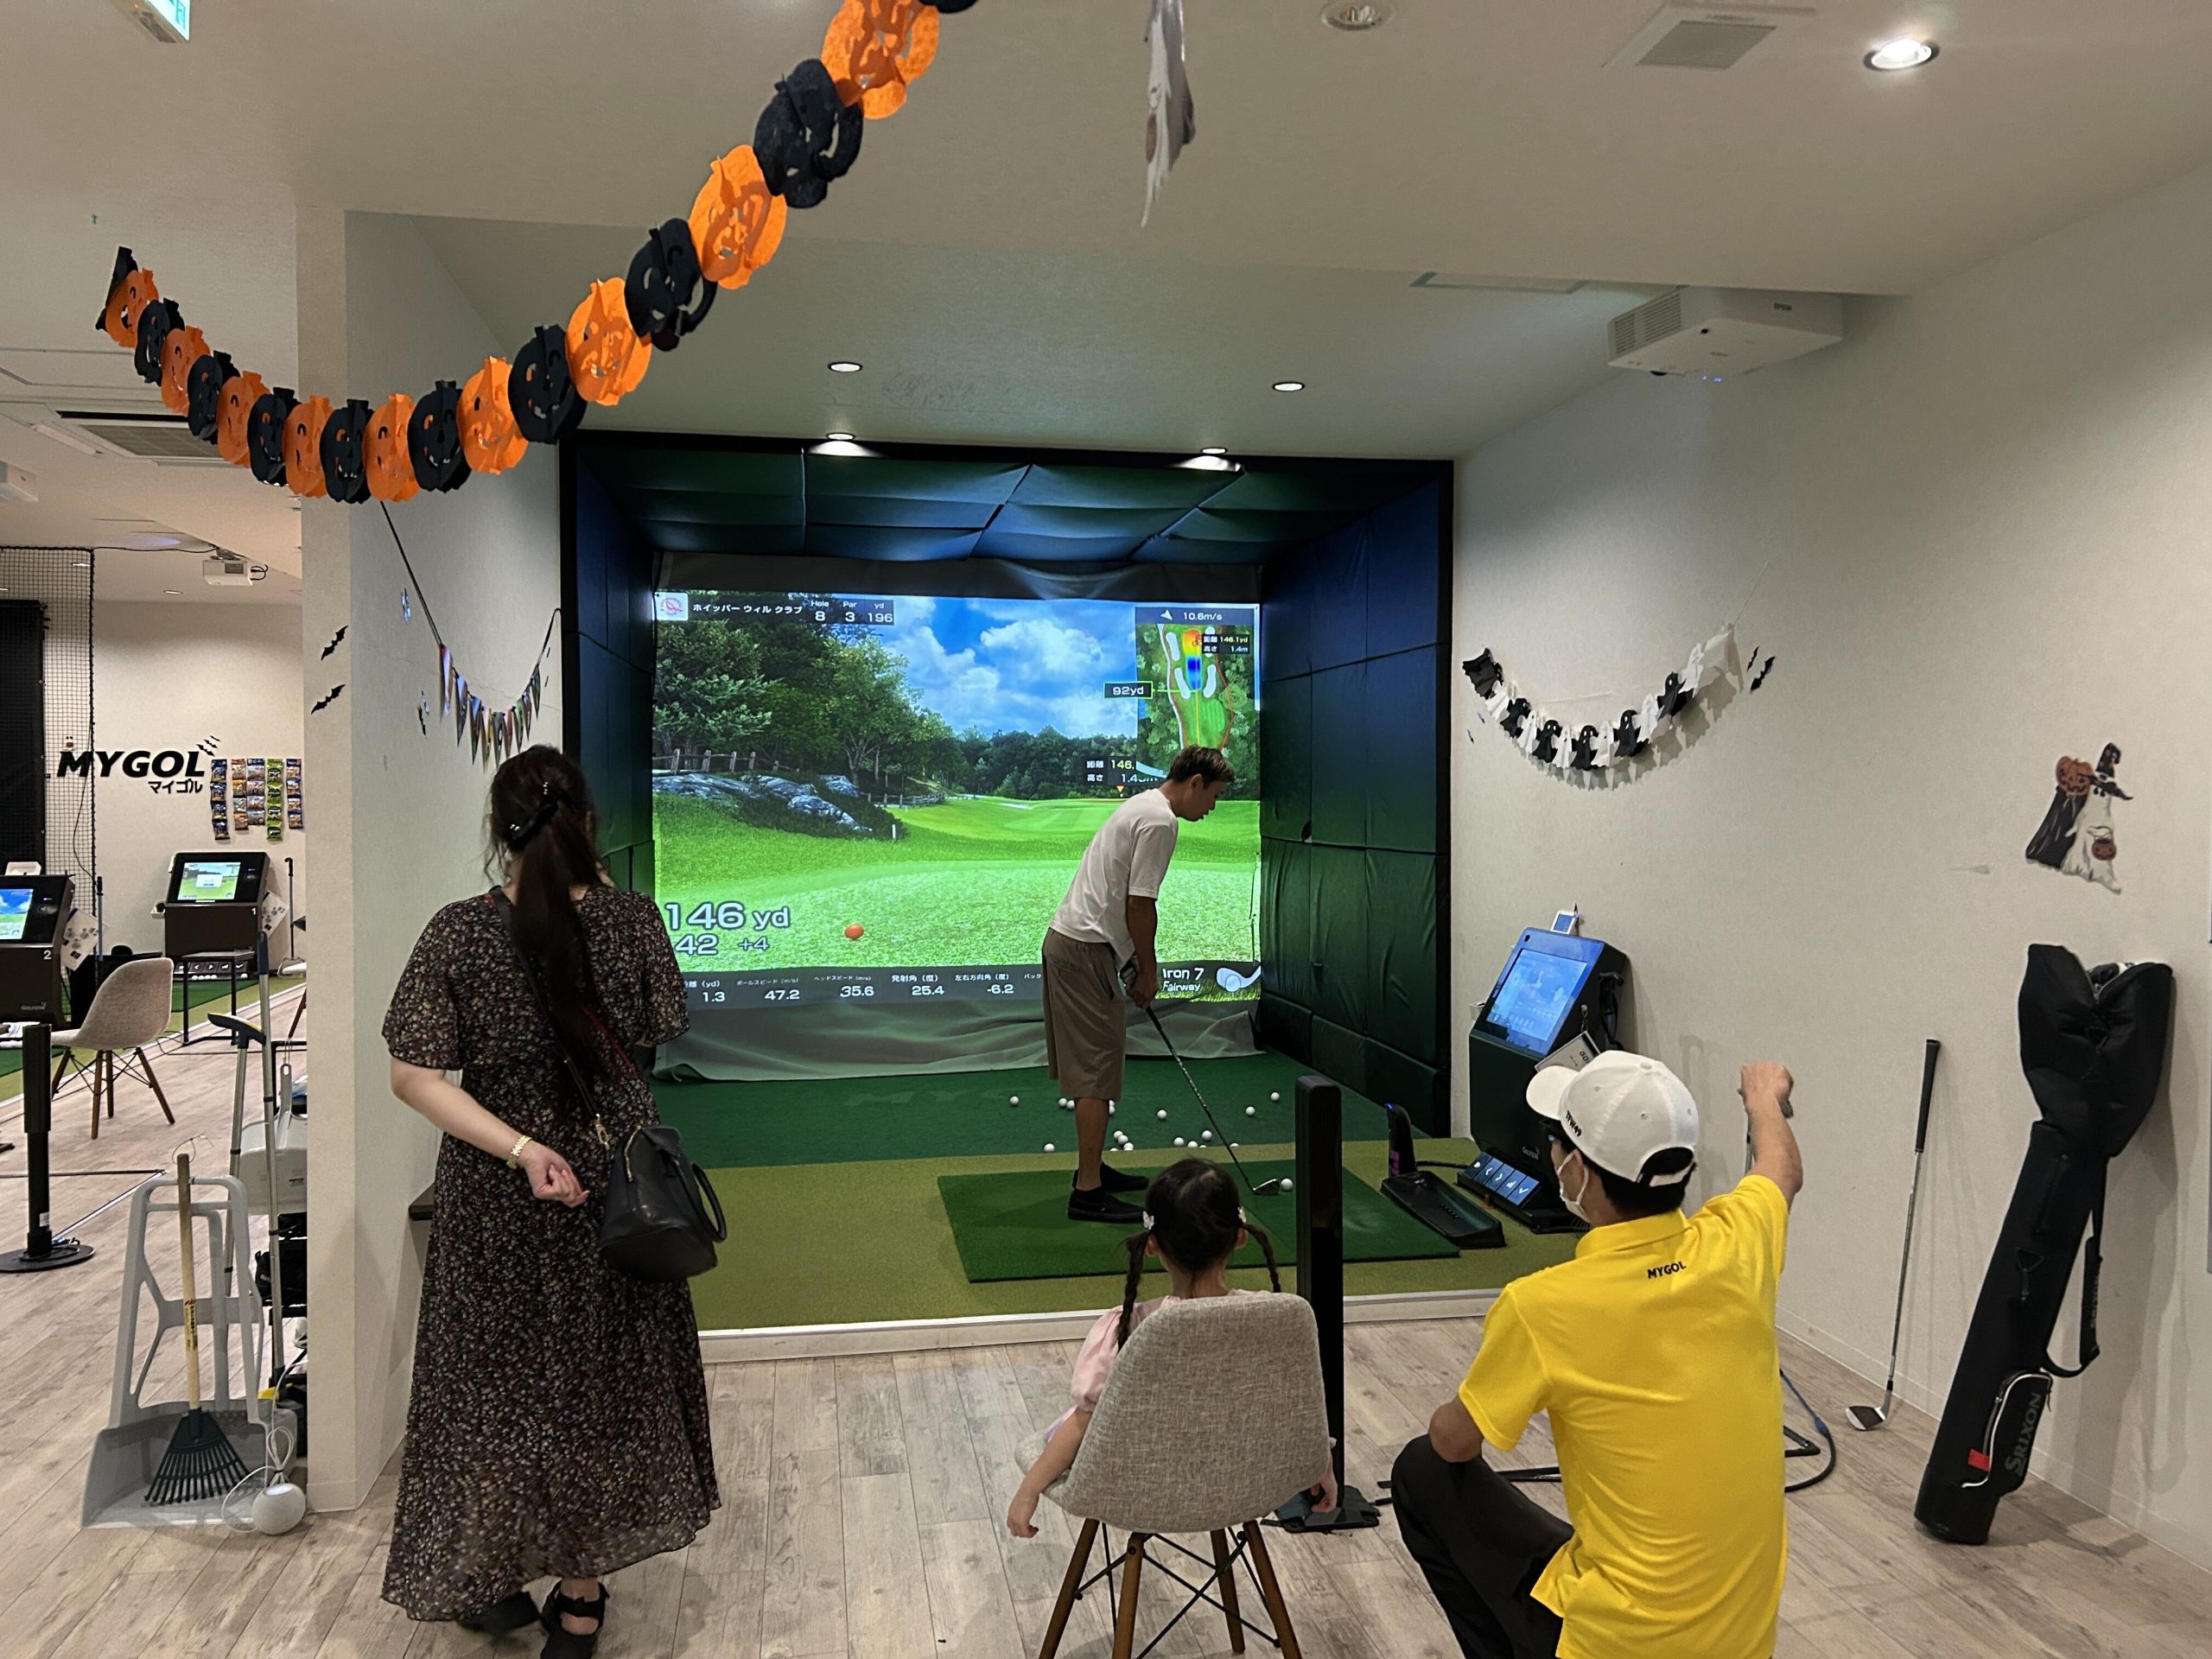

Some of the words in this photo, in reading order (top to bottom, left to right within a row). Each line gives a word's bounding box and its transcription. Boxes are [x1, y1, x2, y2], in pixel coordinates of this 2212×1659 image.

[815, 611, 826, 622] 8
[844, 612, 855, 622] 3
[868, 613, 893, 623] 196
[1183, 612, 1223, 620] 10.6m/s
[1112, 686, 1144, 696] 92yd
[56, 750, 206, 778] MYGOL
[1087, 773, 1103, 782] 高さ
[148, 779, 203, 794] マイゴル
[664, 900, 746, 931] 146
[752, 906, 791, 931] yd
[674, 933, 719, 956] 42
[738, 936, 770, 951] +4
[43, 950, 52, 960] 2
[1162, 968, 1190, 980] Iron
[1194, 968, 1205, 981] 7
[839, 985, 874, 998] 35.6
[912, 985, 944, 995] 25.4
[987, 983, 1014, 995] -6.2
[1162, 981, 1201, 992] Fairway
[702, 991, 726, 1002] 1.3
[764, 989, 800, 1001] 47.2
[1647, 1261, 1687, 1279] MYGOL
[2005, 1392, 2041, 1472] SRIXON
